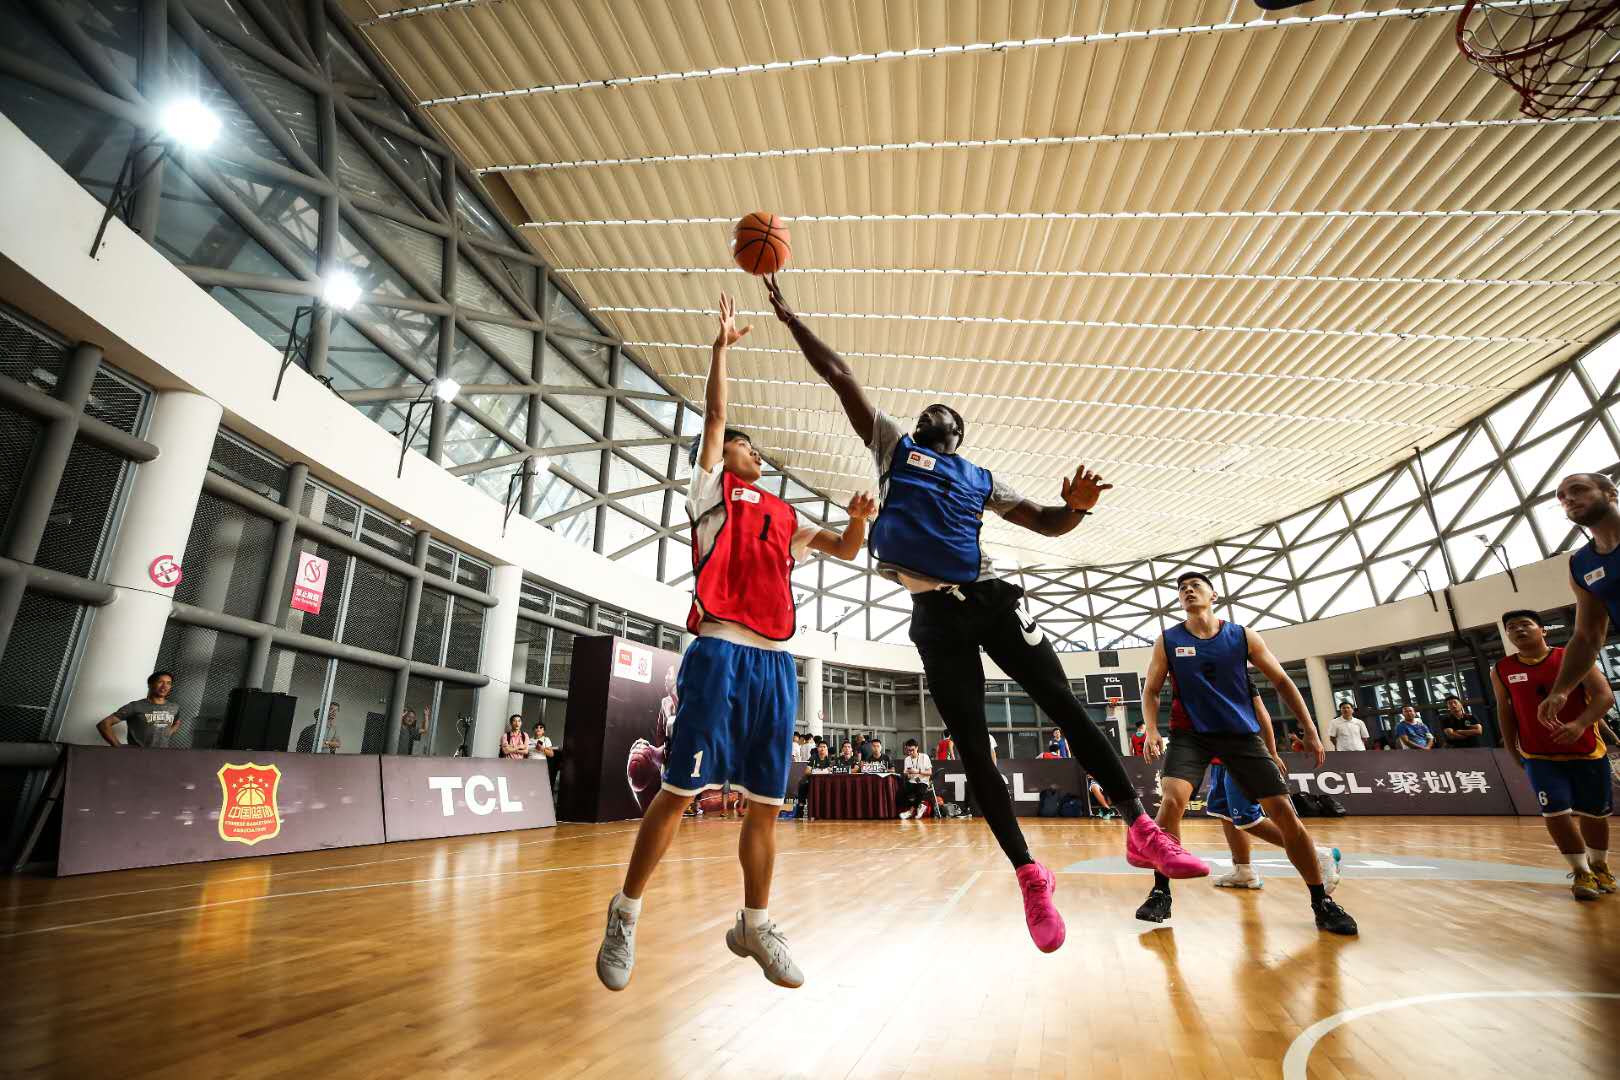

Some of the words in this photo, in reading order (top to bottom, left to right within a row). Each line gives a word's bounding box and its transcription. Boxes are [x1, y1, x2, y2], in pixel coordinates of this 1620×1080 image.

[760, 514, 771, 540] 1
[691, 750, 703, 777] 1
[428, 775, 524, 816] TCL
[944, 772, 1041, 801] TL
[1288, 771, 1373, 795] TCL
[1387, 770, 1491, 796] 聚划算
[1538, 791, 1549, 806] 6
